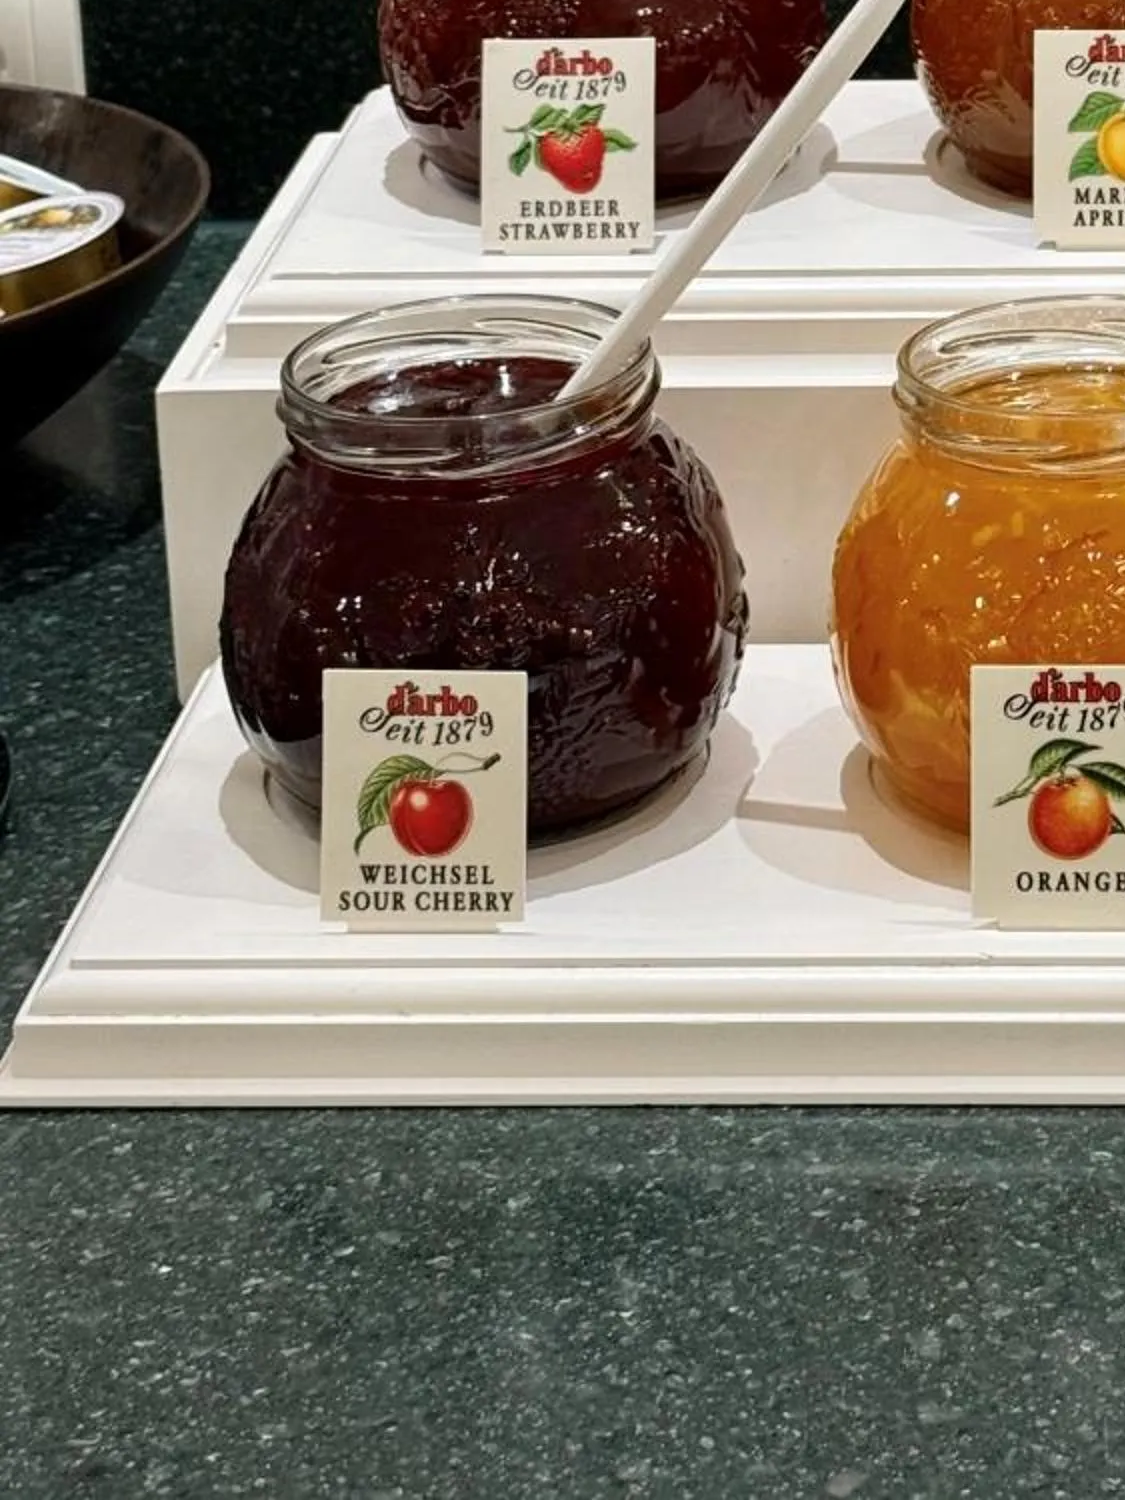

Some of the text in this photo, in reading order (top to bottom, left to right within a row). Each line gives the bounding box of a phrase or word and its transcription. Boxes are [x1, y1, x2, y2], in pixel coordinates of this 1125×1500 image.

[512, 68, 627, 100] Seit 1879
[1065, 55, 1122, 87] Seit
[520, 200, 620, 218] ERDBEER
[499, 222, 640, 241] STRAWBERRY
[1003, 693, 1070, 732] Seit
[359, 706, 493, 746] Seit 1879
[360, 864, 495, 885] WEICHSEL
[339, 891, 514, 912] SOUR CHERRY
